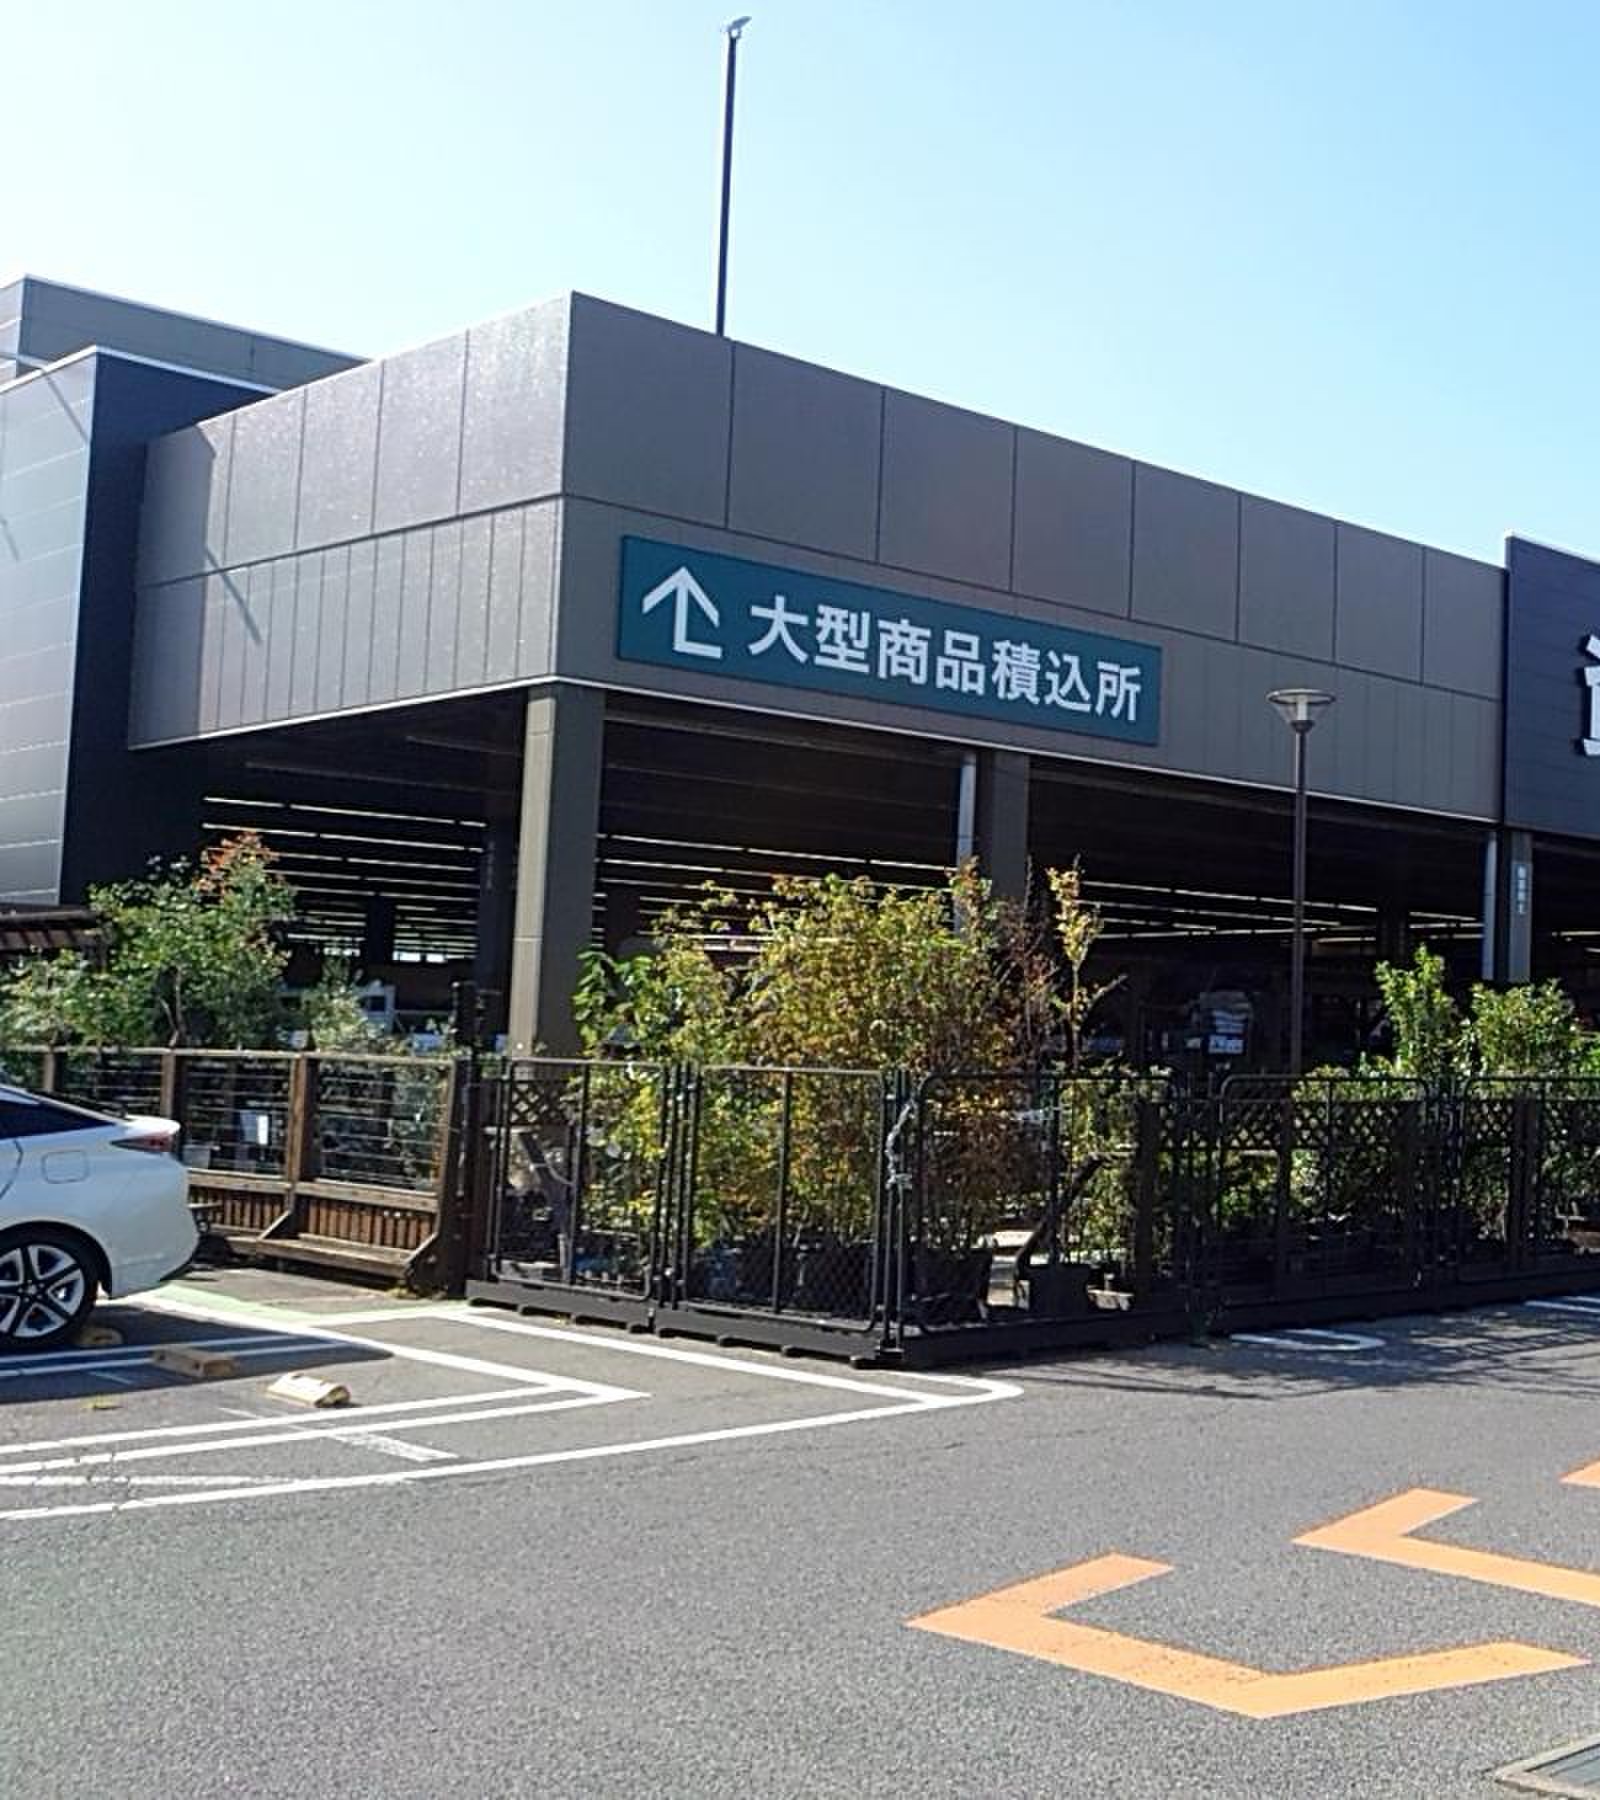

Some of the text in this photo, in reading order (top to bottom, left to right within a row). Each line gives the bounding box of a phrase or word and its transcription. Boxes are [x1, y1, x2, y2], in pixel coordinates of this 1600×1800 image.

[748, 595, 1142, 722] 大型商品積込所
